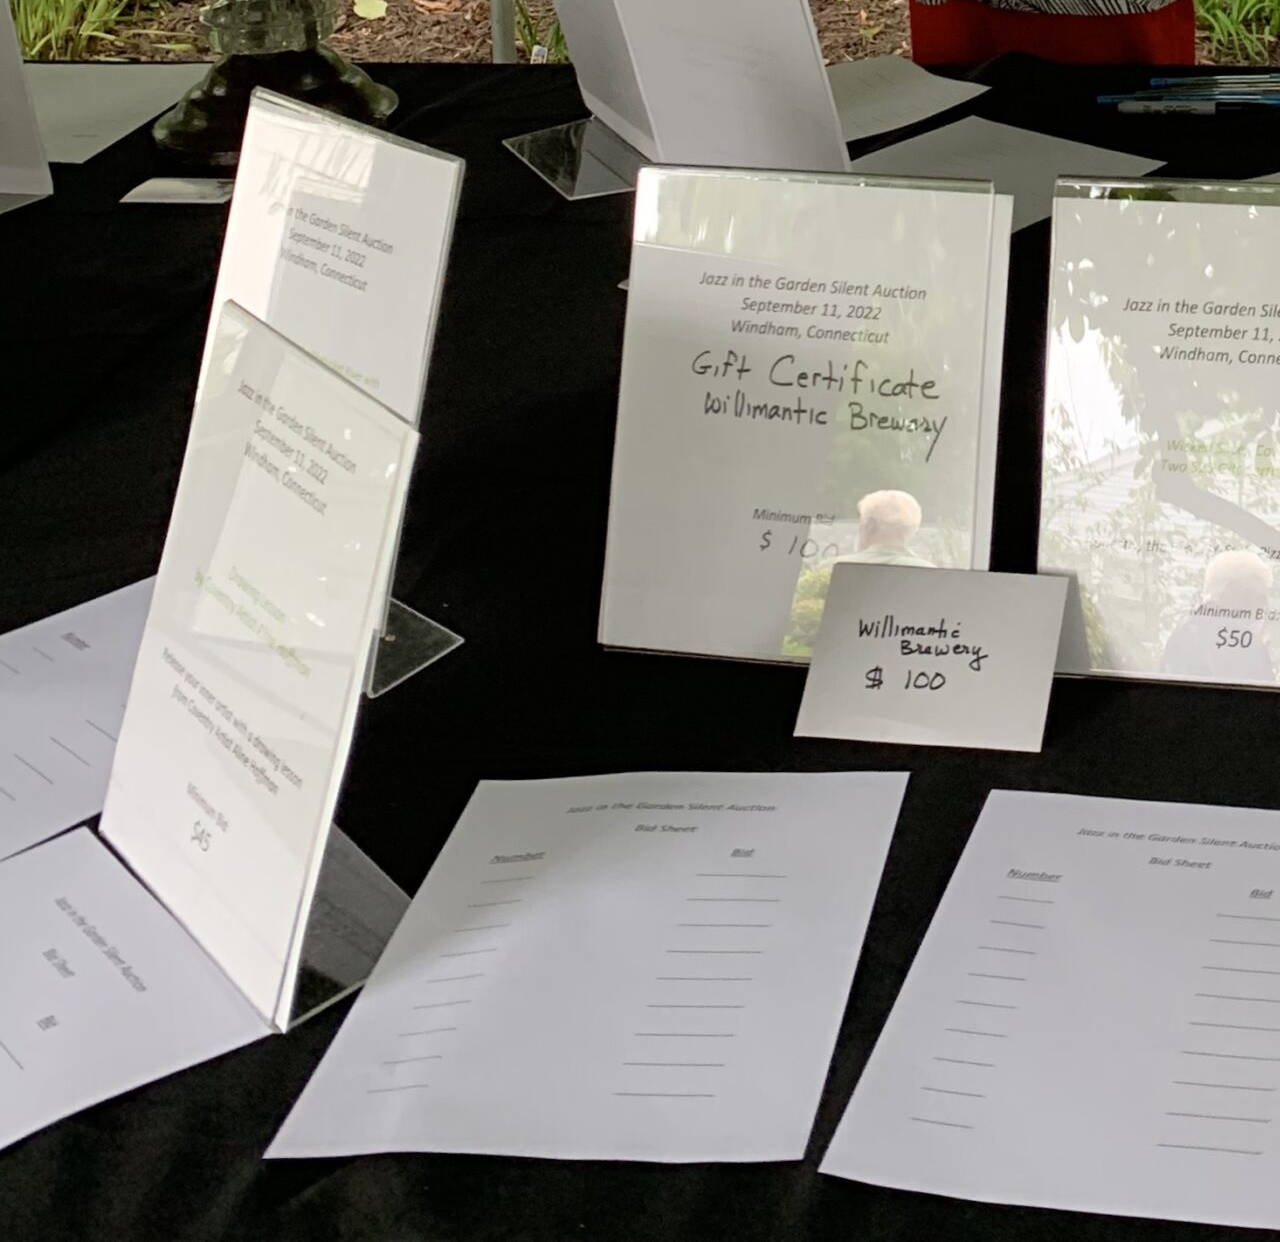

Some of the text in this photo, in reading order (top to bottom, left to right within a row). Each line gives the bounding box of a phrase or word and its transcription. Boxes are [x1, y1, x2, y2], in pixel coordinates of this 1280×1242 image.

[699, 272, 927, 300] Jazz in the Garden Silent Auction
[741, 297, 882, 321] September 11, 2022
[1123, 298, 1154, 312] Jazz
[1156, 298, 1171, 313] in
[1174, 299, 1199, 315] the
[1202, 301, 1256, 317] Garden
[731, 320, 890, 344] Windham, Connecticut
[1168, 323, 1248, 340] September
[1252, 327, 1274, 343] 11,
[1158, 344, 1232, 365] Windham,
[692, 350, 941, 400] Gift Certificate
[752, 508, 812, 525] Minimum
[1190, 604, 1252, 620] Minimum
[858, 615, 962, 640] Willimantic
[1216, 628, 1254, 650] $50
[900, 639, 989, 672] Brewery
[189, 820, 212, 852] $45
[1006, 867, 1275, 901] Number Bid
